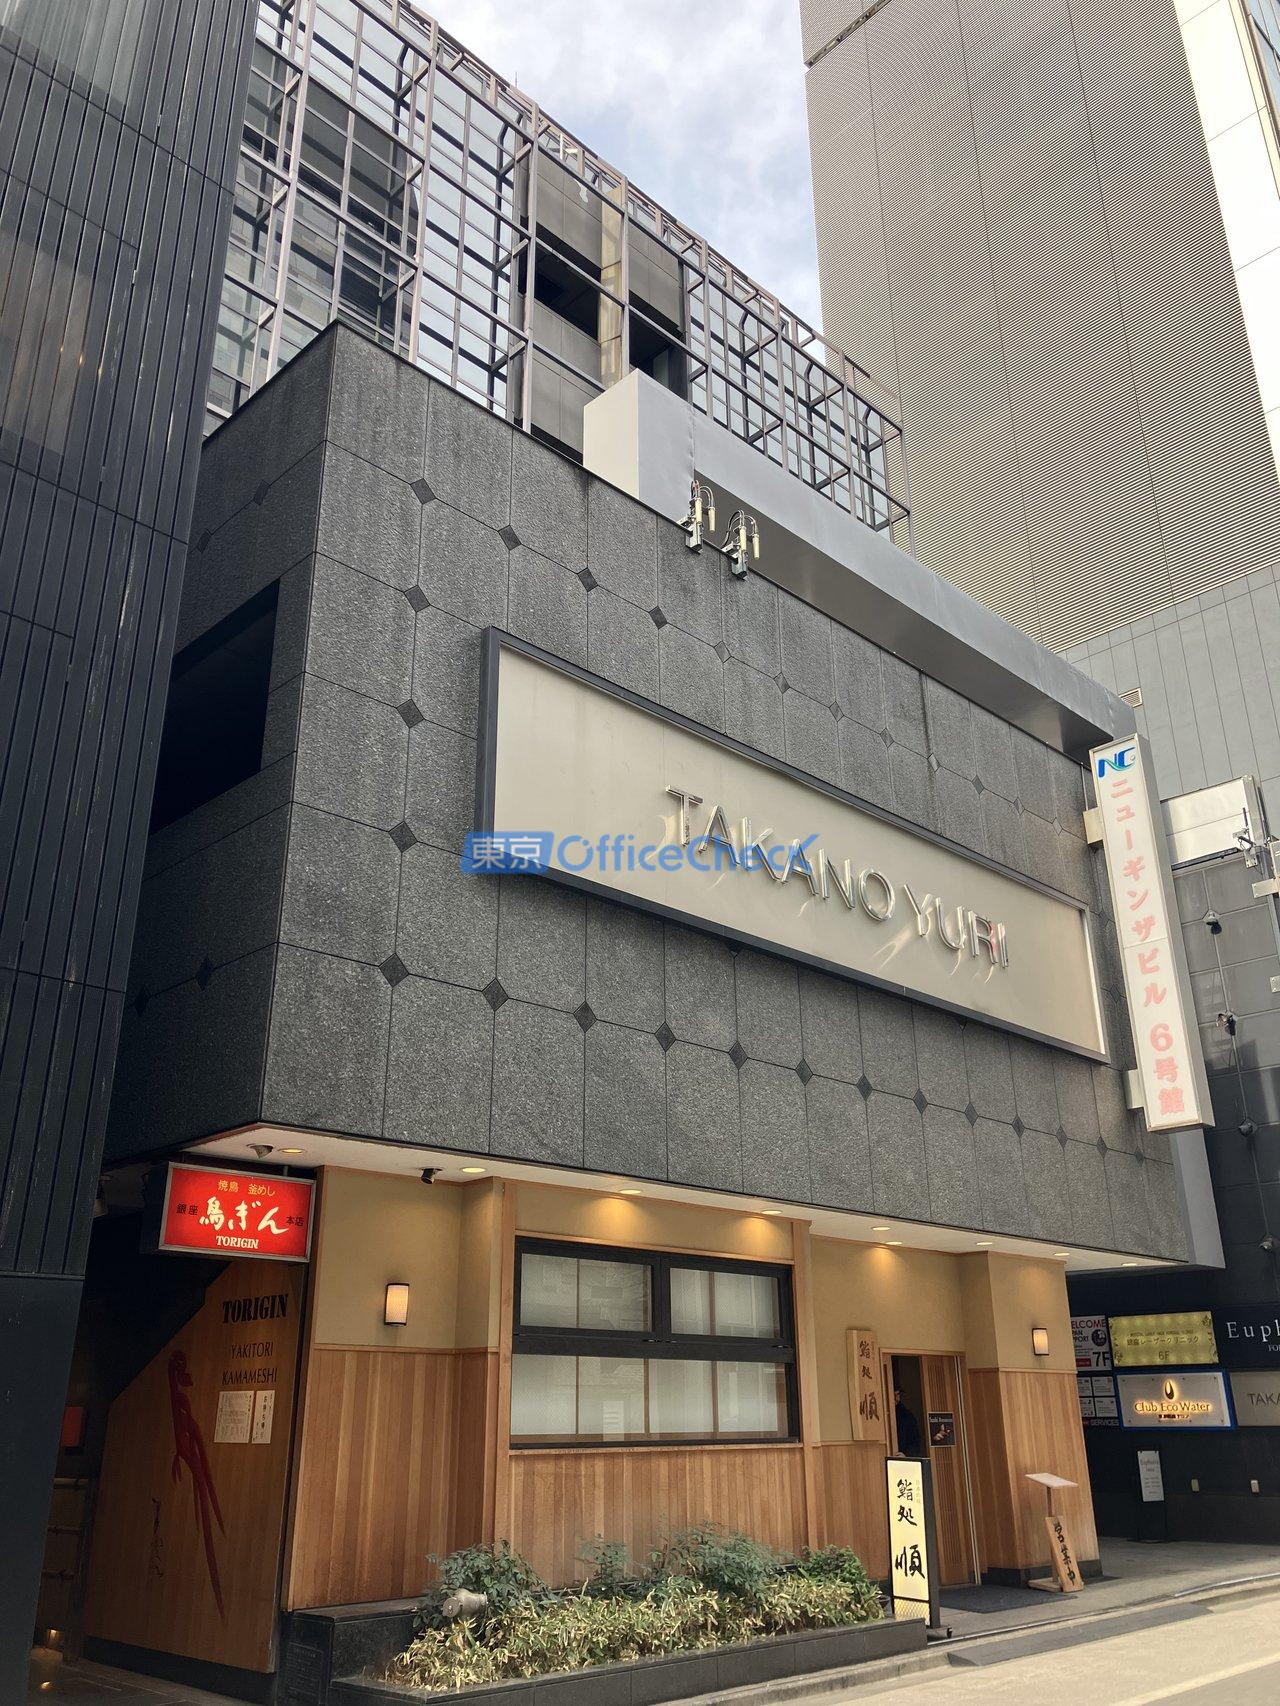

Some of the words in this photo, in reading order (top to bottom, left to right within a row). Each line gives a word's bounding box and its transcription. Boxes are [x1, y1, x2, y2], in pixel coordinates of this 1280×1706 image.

[665, 784, 896, 922] TAKANO
[904, 884, 1009, 969] YURI
[1111, 779, 1167, 1008] ニューギンザビル
[217, 1179, 239, 1193] 焼鳥
[247, 1183, 276, 1196] 釜めし
[176, 1203, 199, 1216] 銀座
[199, 1196, 289, 1235] 鳥ぎん
[286, 1215, 305, 1227] 本店
[215, 1235, 260, 1249] TORIGIN
[222, 1293, 289, 1324] TORIGIN
[1071, 1318, 1106, 1329] ELCOME
[231, 1341, 274, 1360] YAKITORI
[1092, 1351, 1110, 1367] 7F
[221, 1367, 278, 1386] KAMAMESHI
[1134, 1402, 1158, 1412] Club
[1160, 1402, 1178, 1412] Eco
[1179, 1401, 1210, 1412] Water
[894, 1543, 926, 1580] 順
